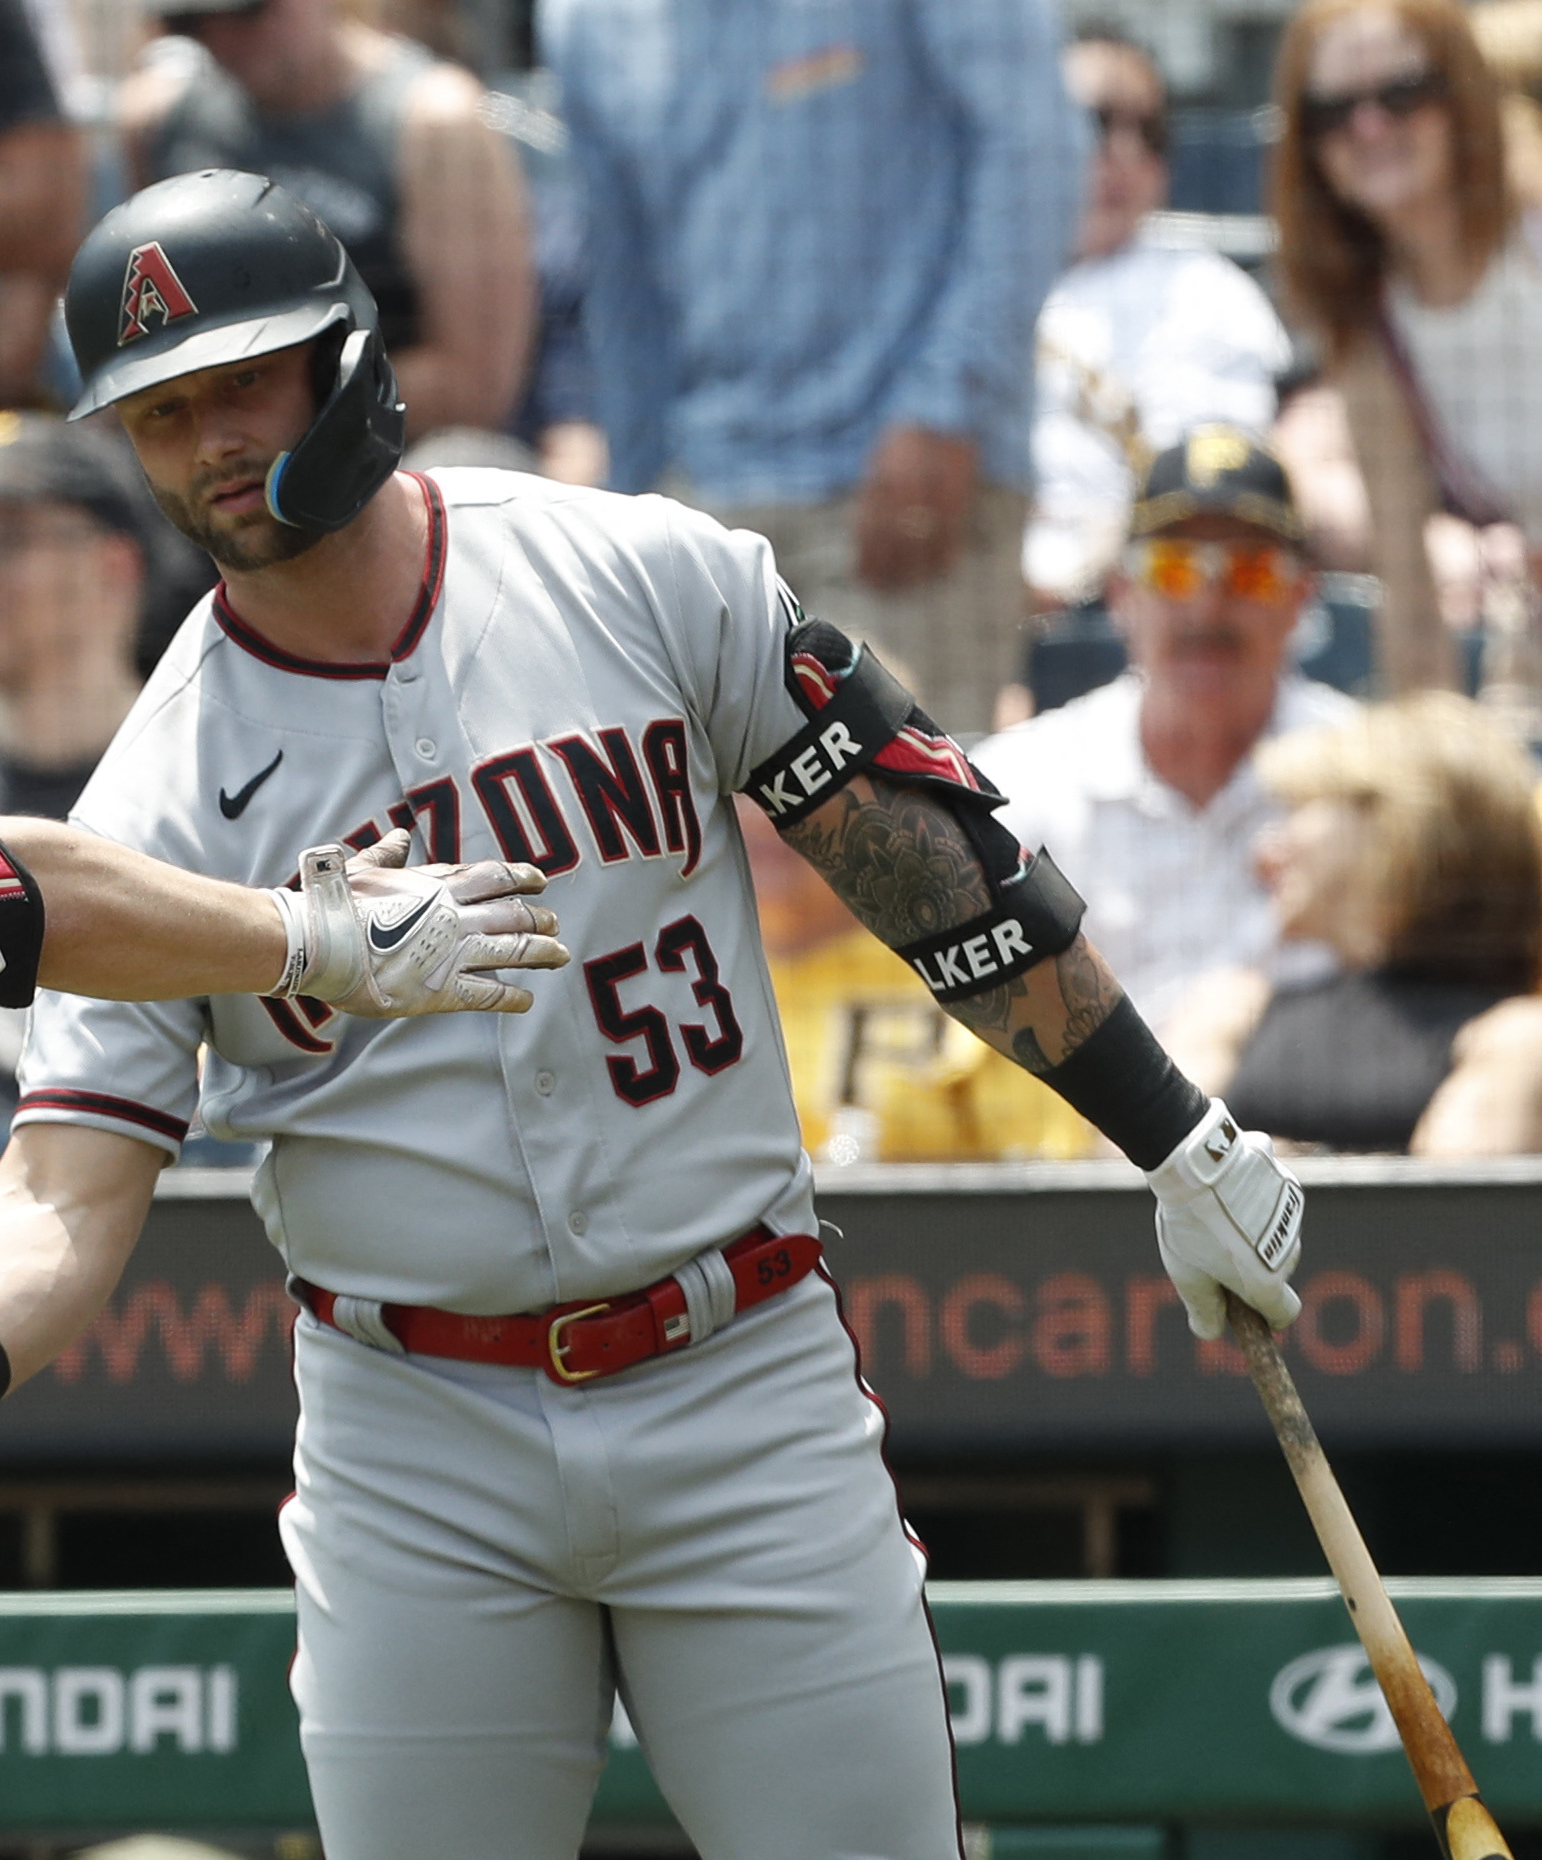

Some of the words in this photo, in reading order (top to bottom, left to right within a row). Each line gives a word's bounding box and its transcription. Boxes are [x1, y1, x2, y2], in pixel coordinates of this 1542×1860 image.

[758, 720, 864, 817] KER
[582, 913, 744, 1108] 53
[757, 1249, 793, 1285] 53
